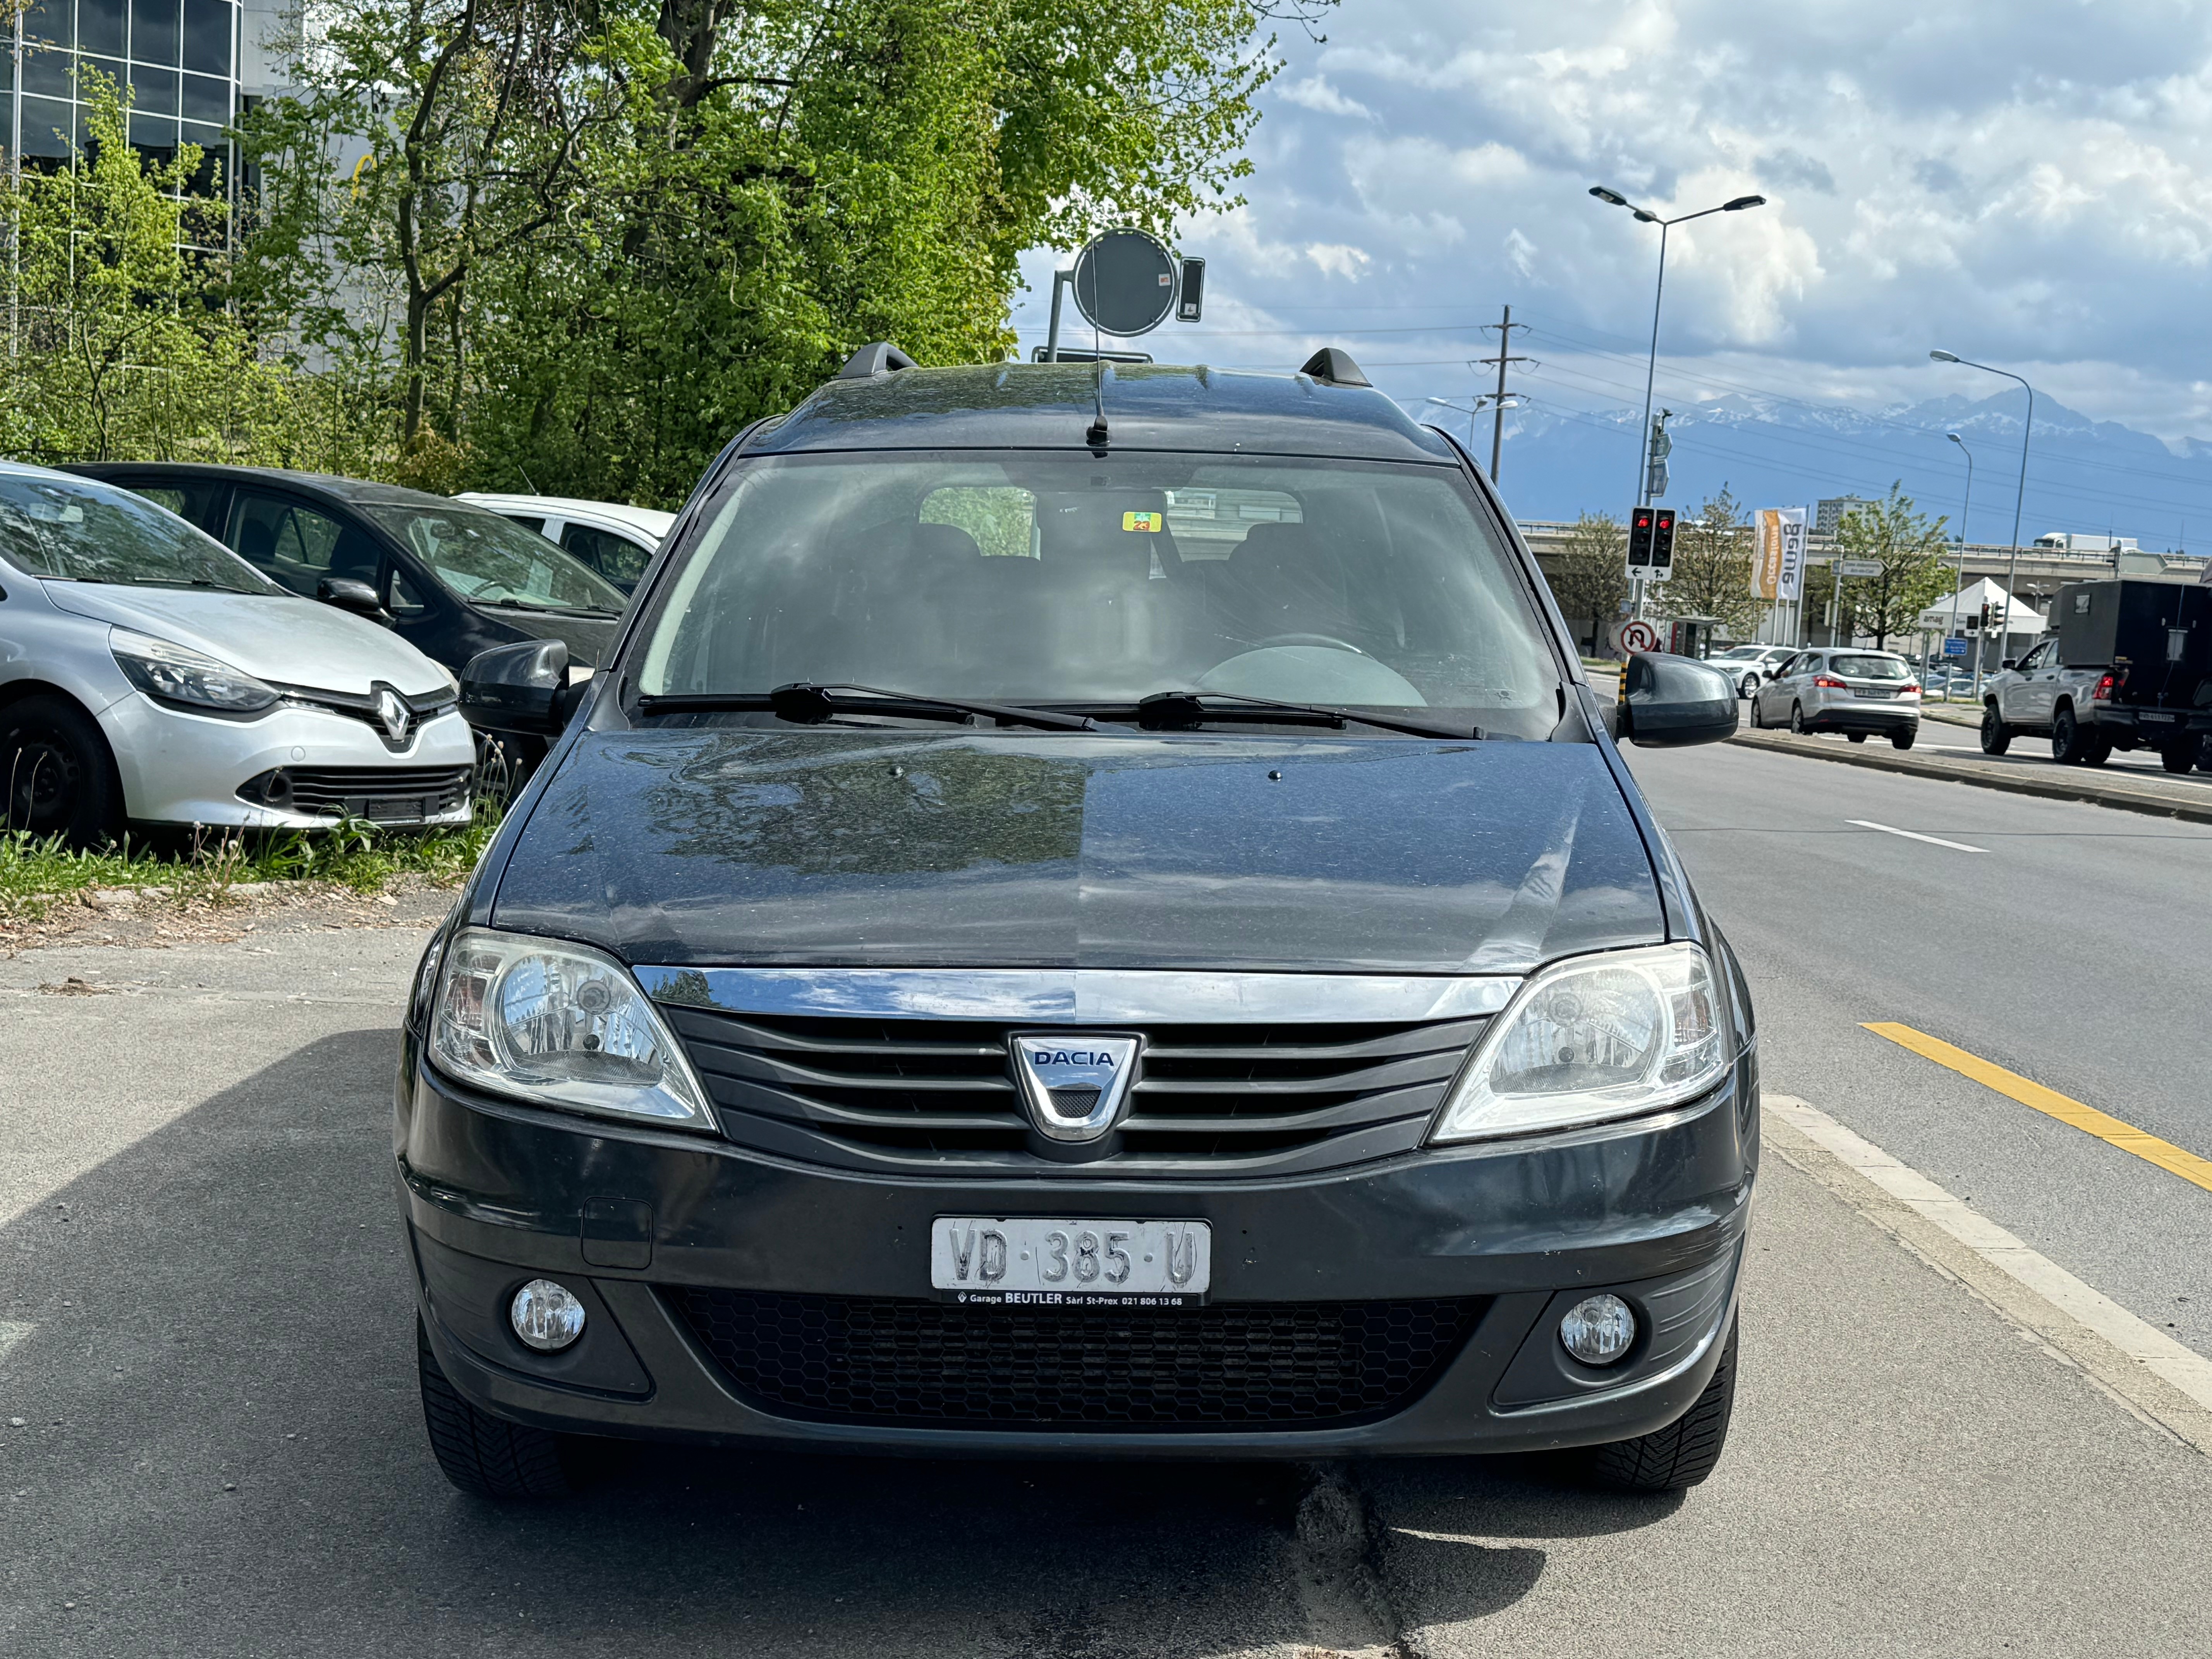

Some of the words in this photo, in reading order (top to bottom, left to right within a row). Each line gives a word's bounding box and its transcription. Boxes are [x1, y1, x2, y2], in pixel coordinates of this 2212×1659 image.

[1034, 1052, 1114, 1066] DACIA
[949, 1228, 1007, 1281] VD
[1042, 1230, 1131, 1283] 385
[1166, 1232, 1194, 1284] U
[970, 1294, 1001, 1304] Garage
[1005, 1292, 1062, 1304] BEUTLER
[1086, 1297, 1118, 1305] St-Prex
